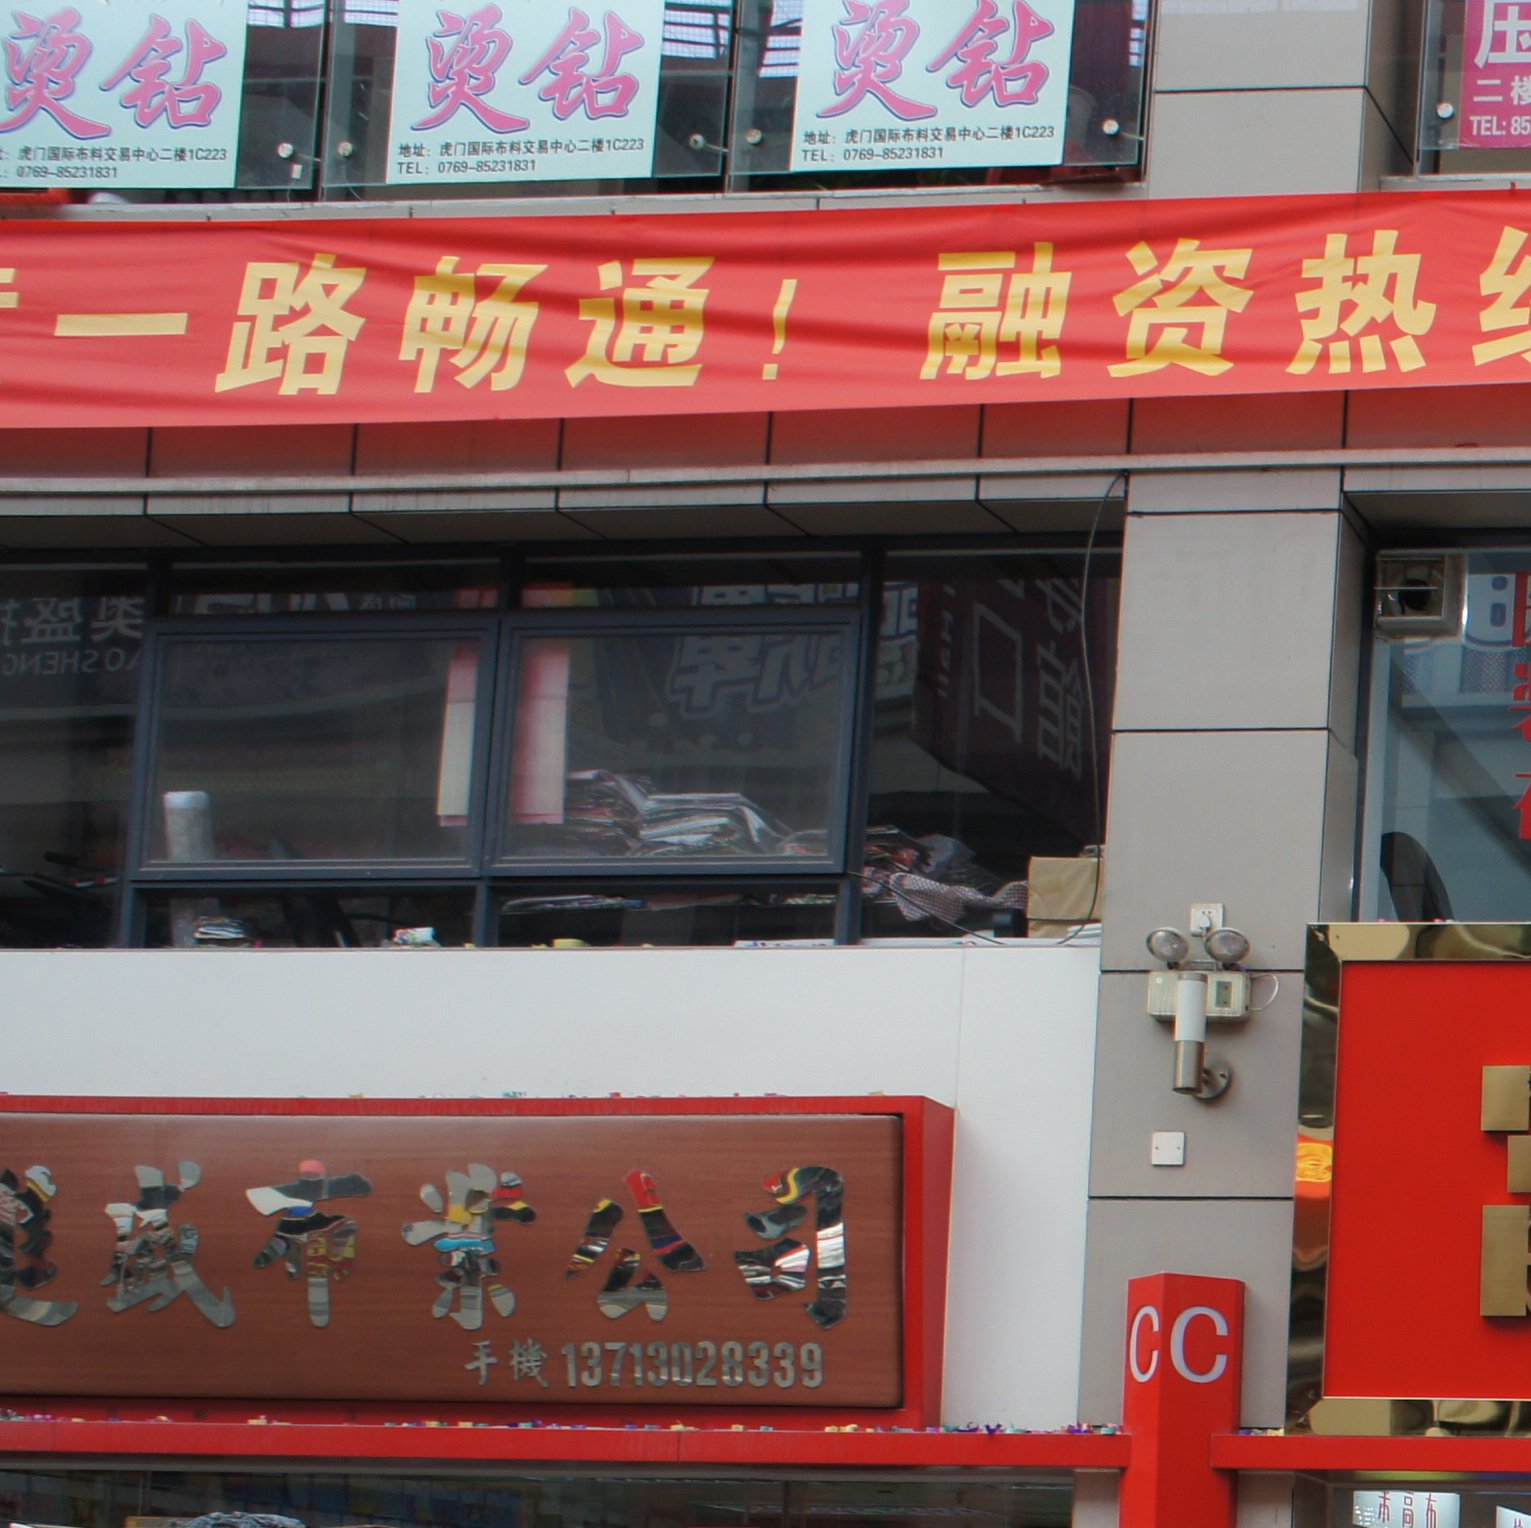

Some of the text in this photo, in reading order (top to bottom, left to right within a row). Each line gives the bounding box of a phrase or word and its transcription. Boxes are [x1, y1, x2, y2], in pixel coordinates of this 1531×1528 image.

[0, 5, 228, 140] 烫钻
[410, 2, 645, 133] 烫钻
[816, 0, 1054, 120] 烫钻
[1470, 116, 1506, 135] TEL:
[561, 1341, 824, 1391] 13713028339
